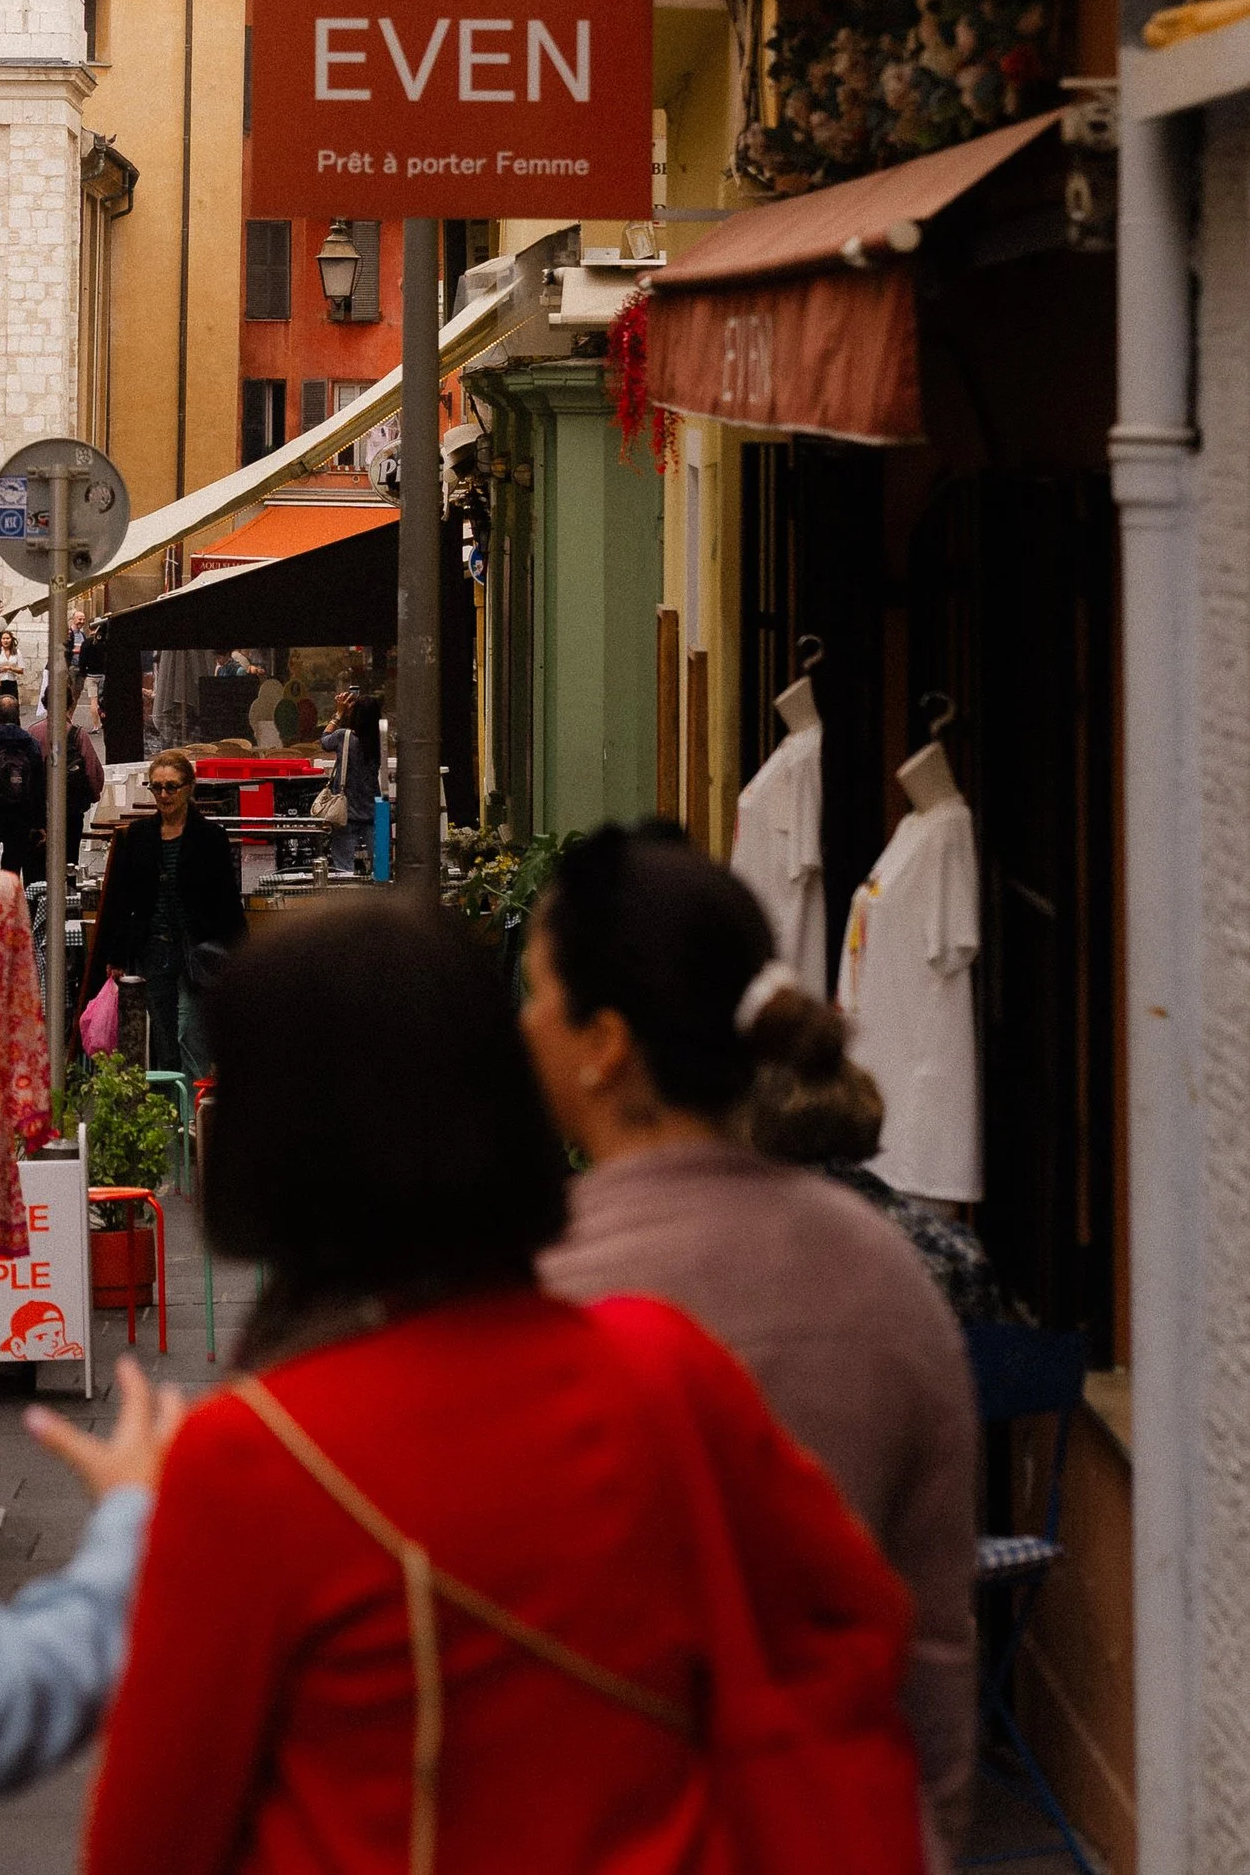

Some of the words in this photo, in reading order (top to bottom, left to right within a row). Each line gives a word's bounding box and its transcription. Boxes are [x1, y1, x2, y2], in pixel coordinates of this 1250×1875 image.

[314, 17, 591, 102] EVEN
[317, 150, 375, 173] Prêt
[383, 153, 398, 175] à
[406, 153, 487, 177] porter
[496, 153, 590, 176] Femme
